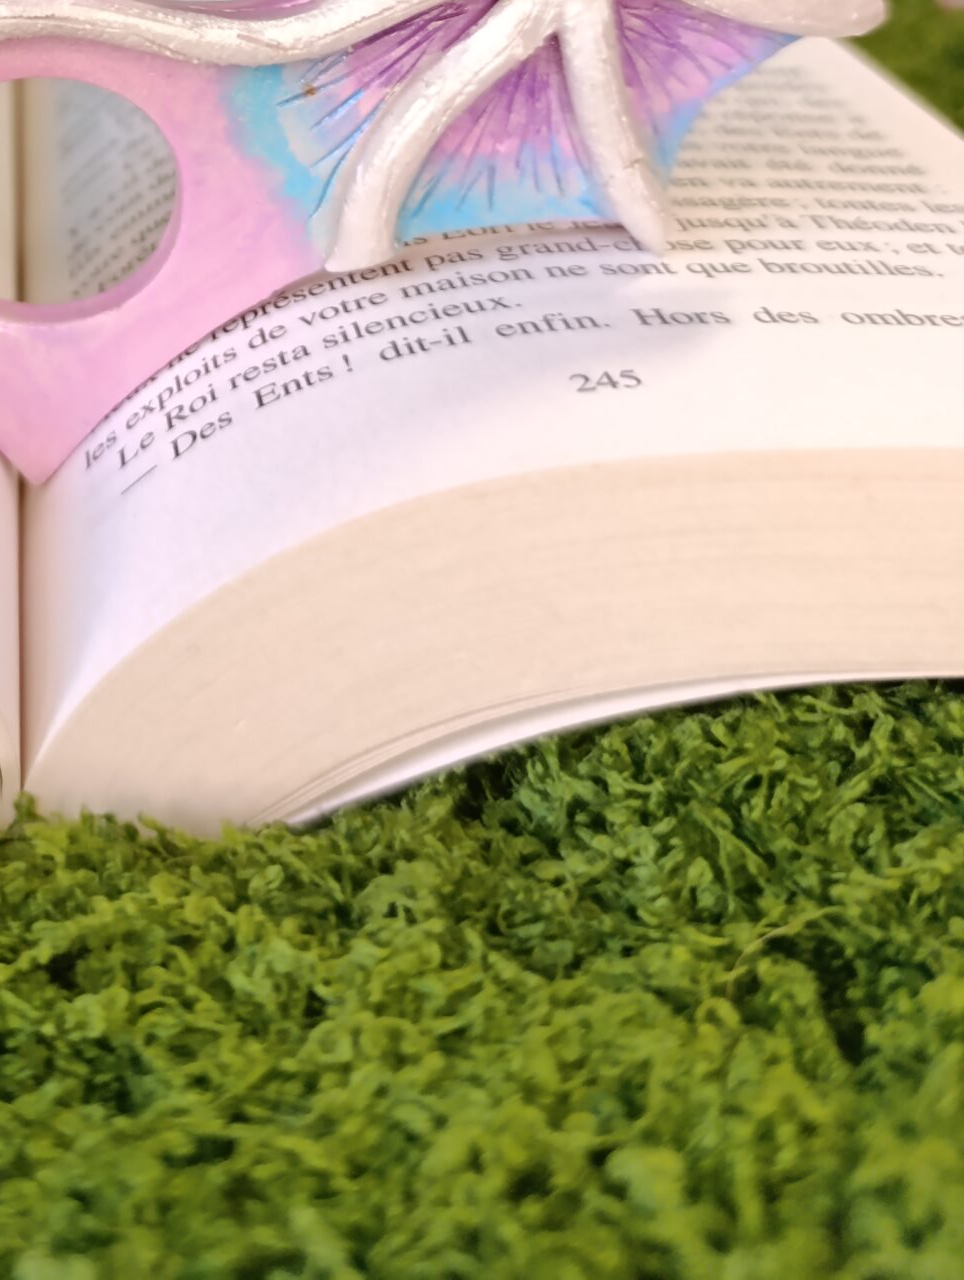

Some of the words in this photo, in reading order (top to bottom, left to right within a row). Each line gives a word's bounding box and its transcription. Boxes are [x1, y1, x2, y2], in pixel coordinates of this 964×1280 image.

[675, 213, 799, 232] jusqu'à
[800, 214, 957, 234] Théoden
[208, 258, 415, 343] représentent
[423, 247, 485, 272] pas
[723, 238, 807, 254] pour
[906, 241, 943, 255] et
[85, 429, 118, 471] les
[125, 346, 239, 431] exploits
[248, 323, 287, 350] de
[299, 291, 389, 327] votre
[400, 267, 535, 300] maison
[544, 263, 590, 279] ne
[599, 261, 678, 276] sont
[685, 261, 753, 279] que
[757, 257, 945, 278] broutilles.
[118, 430, 156, 469] Le
[163, 382, 219, 433] Roi
[228, 342, 311, 392] resta
[321, 295, 524, 350] silencieux.
[169, 411, 234, 461] Des
[378, 325, 473, 362] dit-il
[495, 312, 612, 338] enfin.
[629, 307, 732, 327] Hors
[752, 306, 821, 325] des
[840, 308, 964, 327] ombre
[569, 369, 643, 394] 245
